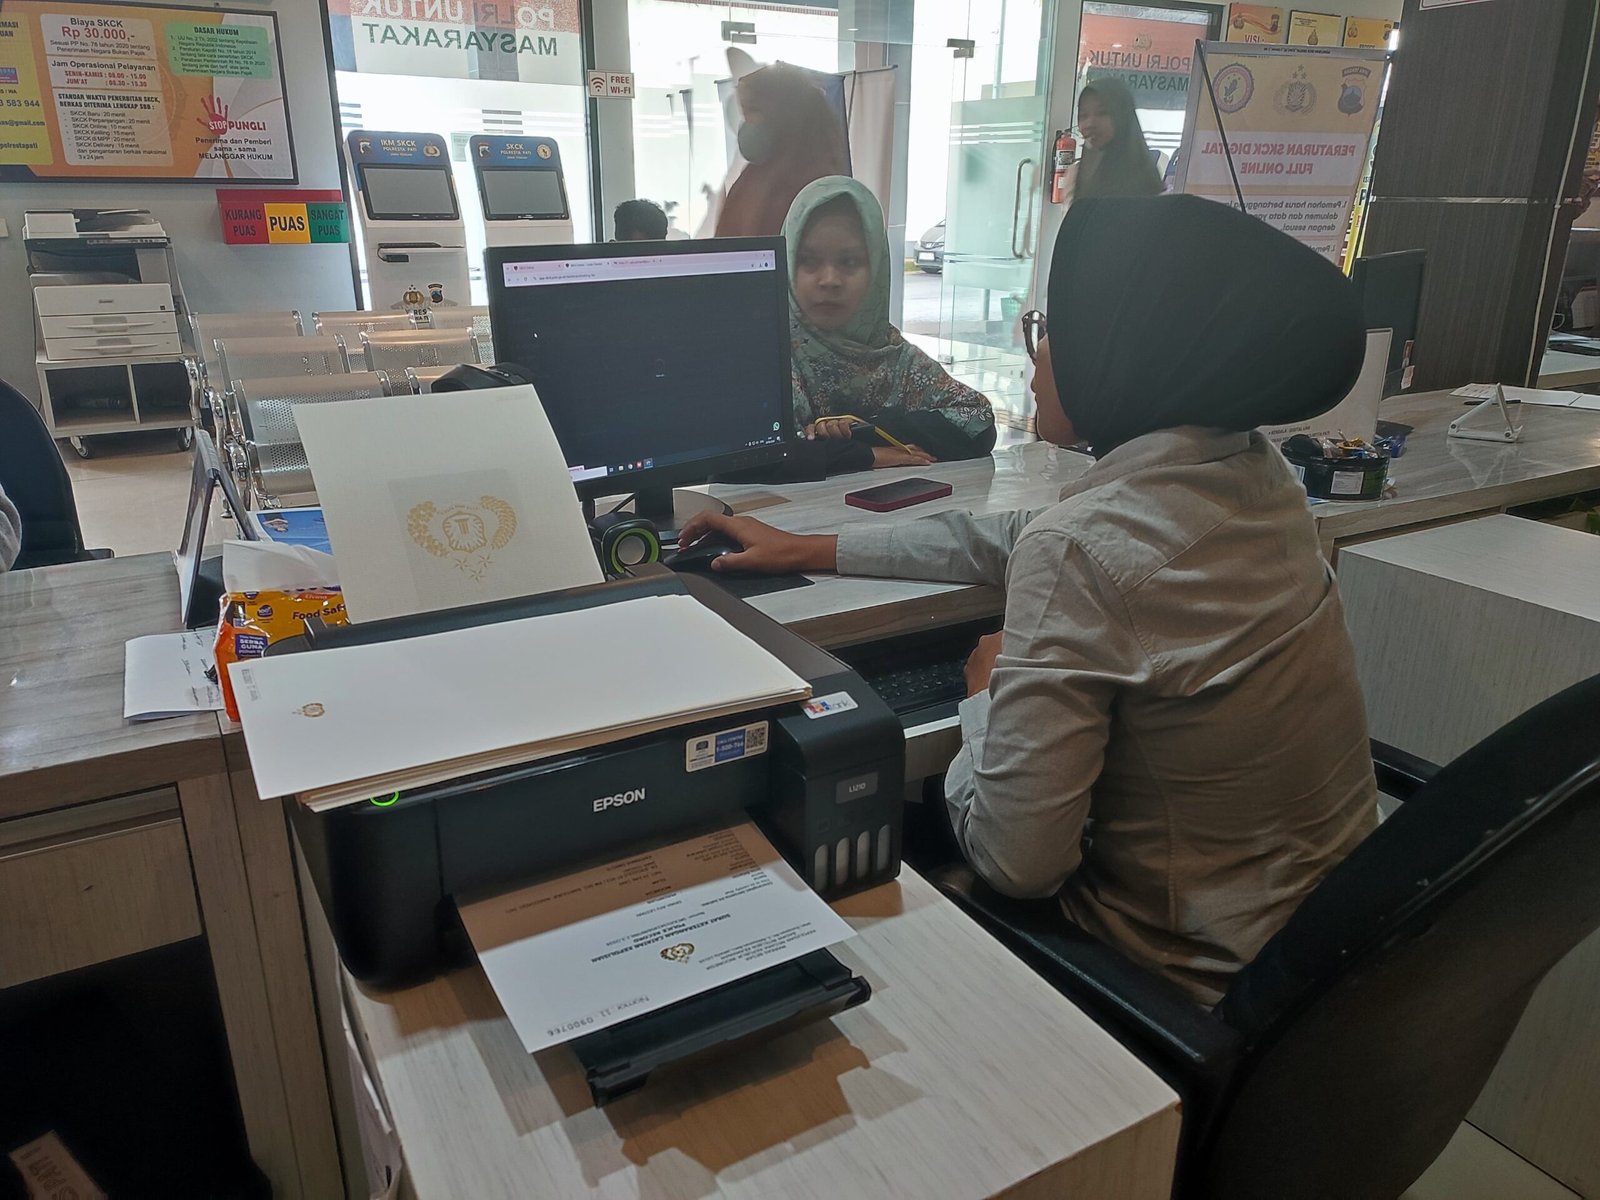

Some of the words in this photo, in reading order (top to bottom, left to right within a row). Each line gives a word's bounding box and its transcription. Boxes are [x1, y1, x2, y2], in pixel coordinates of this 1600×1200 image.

[70, 18, 94, 27] Biaya
[98, 19, 123, 27] SKCK
[62, 26, 80, 40] Rp
[70, 61, 116, 69] Operasional
[118, 63, 156, 71] Pelayanan
[209, 121, 227, 130] STOP
[228, 121, 266, 131] PUNGLI
[225, 209, 262, 220] KURANG
[310, 210, 344, 220] SANGAT
[269, 216, 305, 231] PUAS
[233, 225, 256, 236] PUAS
[318, 225, 339, 236] PUAS
[292, 610, 320, 620] Food
[593, 788, 646, 812] EPSON
